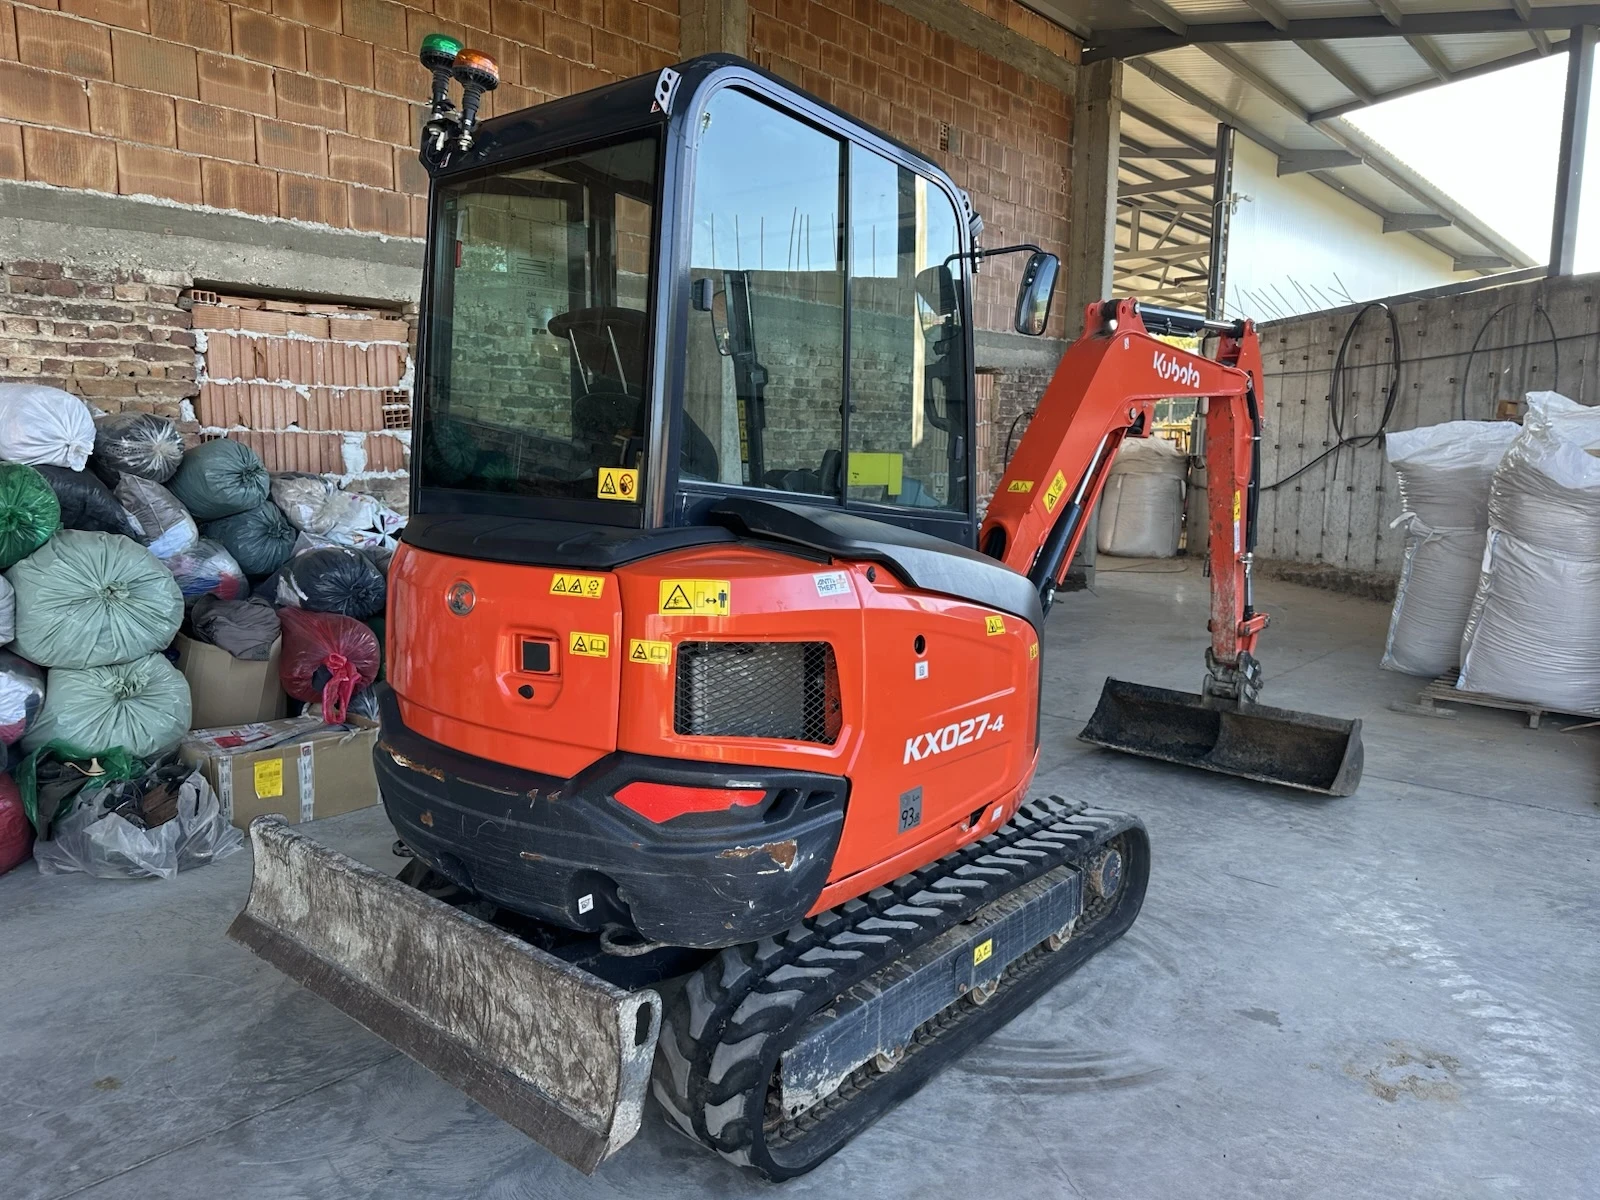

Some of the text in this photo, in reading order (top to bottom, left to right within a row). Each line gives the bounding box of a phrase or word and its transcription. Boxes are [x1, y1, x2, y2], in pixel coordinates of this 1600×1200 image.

[1153, 351, 1200, 389] Kubota
[817, 584, 837, 592] THEFT
[903, 713, 1005, 765] KX027-4
[901, 807, 915, 829] 93
